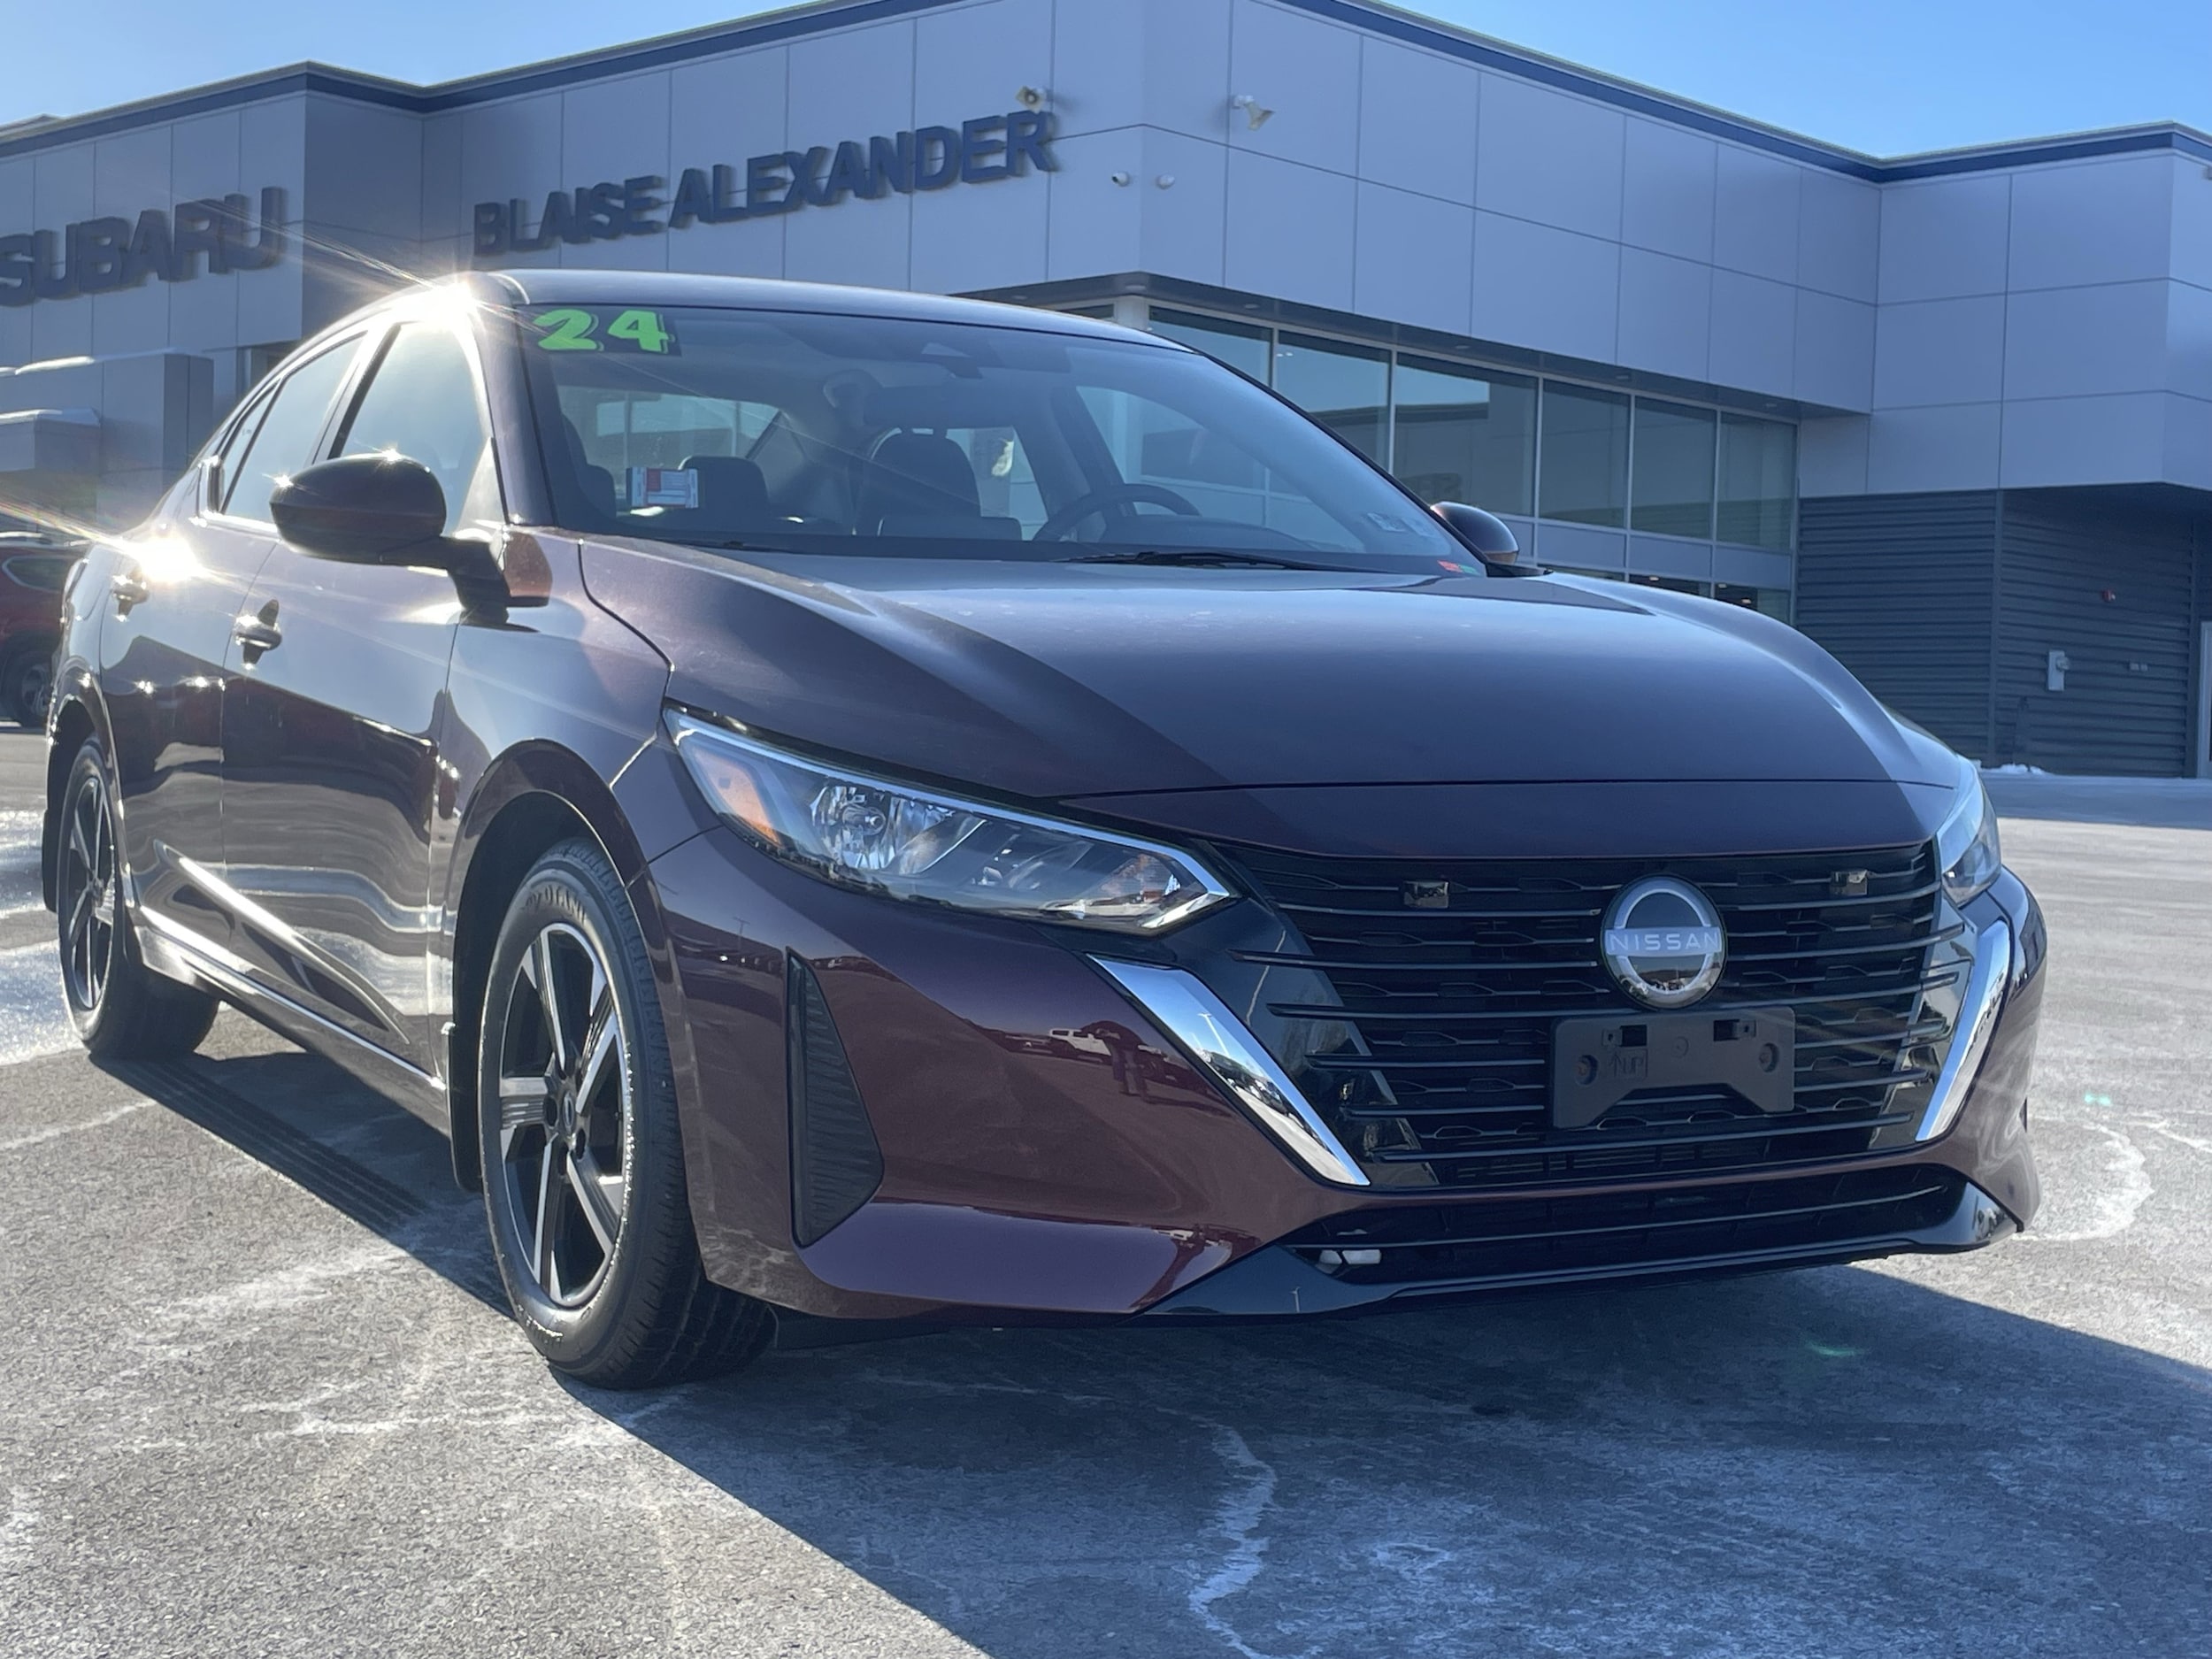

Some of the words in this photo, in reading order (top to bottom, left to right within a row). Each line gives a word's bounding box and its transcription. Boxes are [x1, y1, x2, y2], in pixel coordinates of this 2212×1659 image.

[473, 174, 665, 257] BLAISE
[668, 109, 1058, 228] ALEXANDER
[0, 186, 285, 307] SUBARU
[533, 308, 672, 354] 24
[1610, 932, 1719, 951] NISSAN
